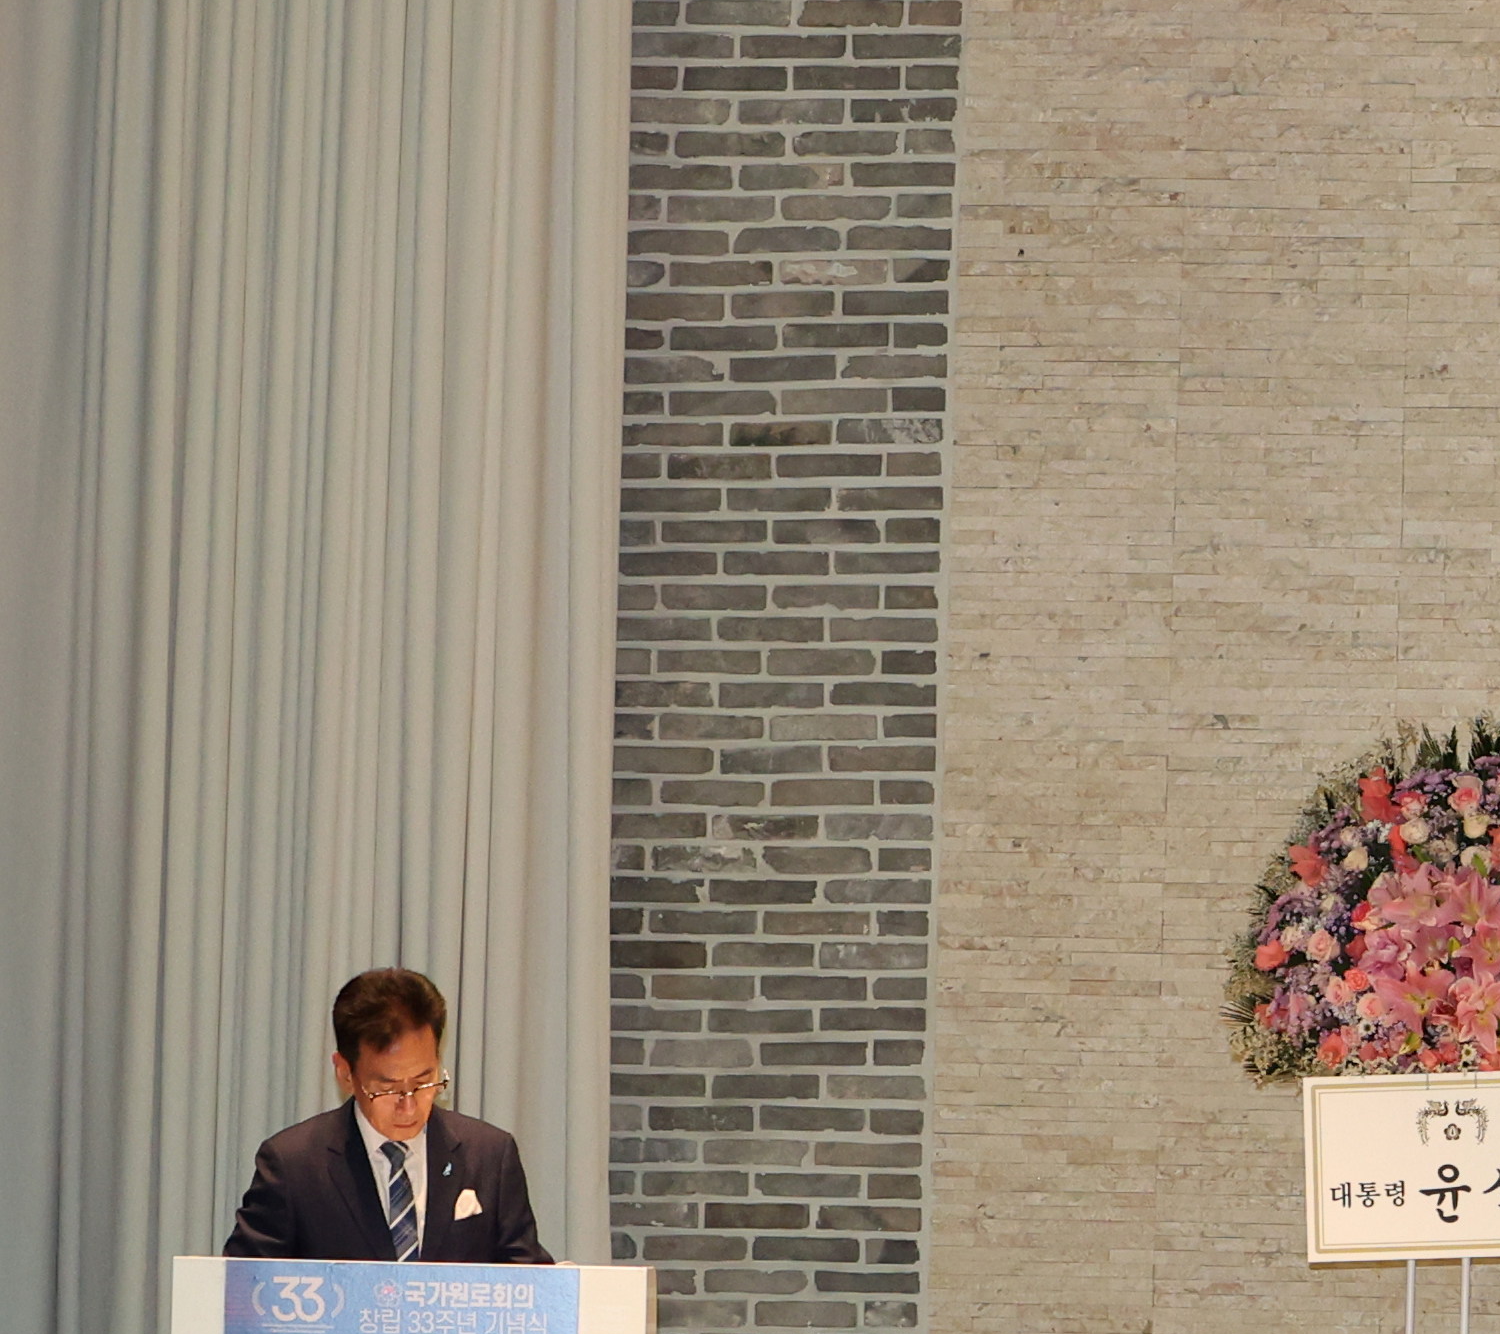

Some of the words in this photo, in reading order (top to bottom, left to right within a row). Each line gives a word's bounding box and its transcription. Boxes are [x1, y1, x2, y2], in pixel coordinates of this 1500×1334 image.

[1330, 1180, 1406, 1208] 대통령
[272, 1276, 326, 1322] 33
[404, 1280, 535, 1309] 국가원로회의
[359, 1308, 401, 1334] 창립
